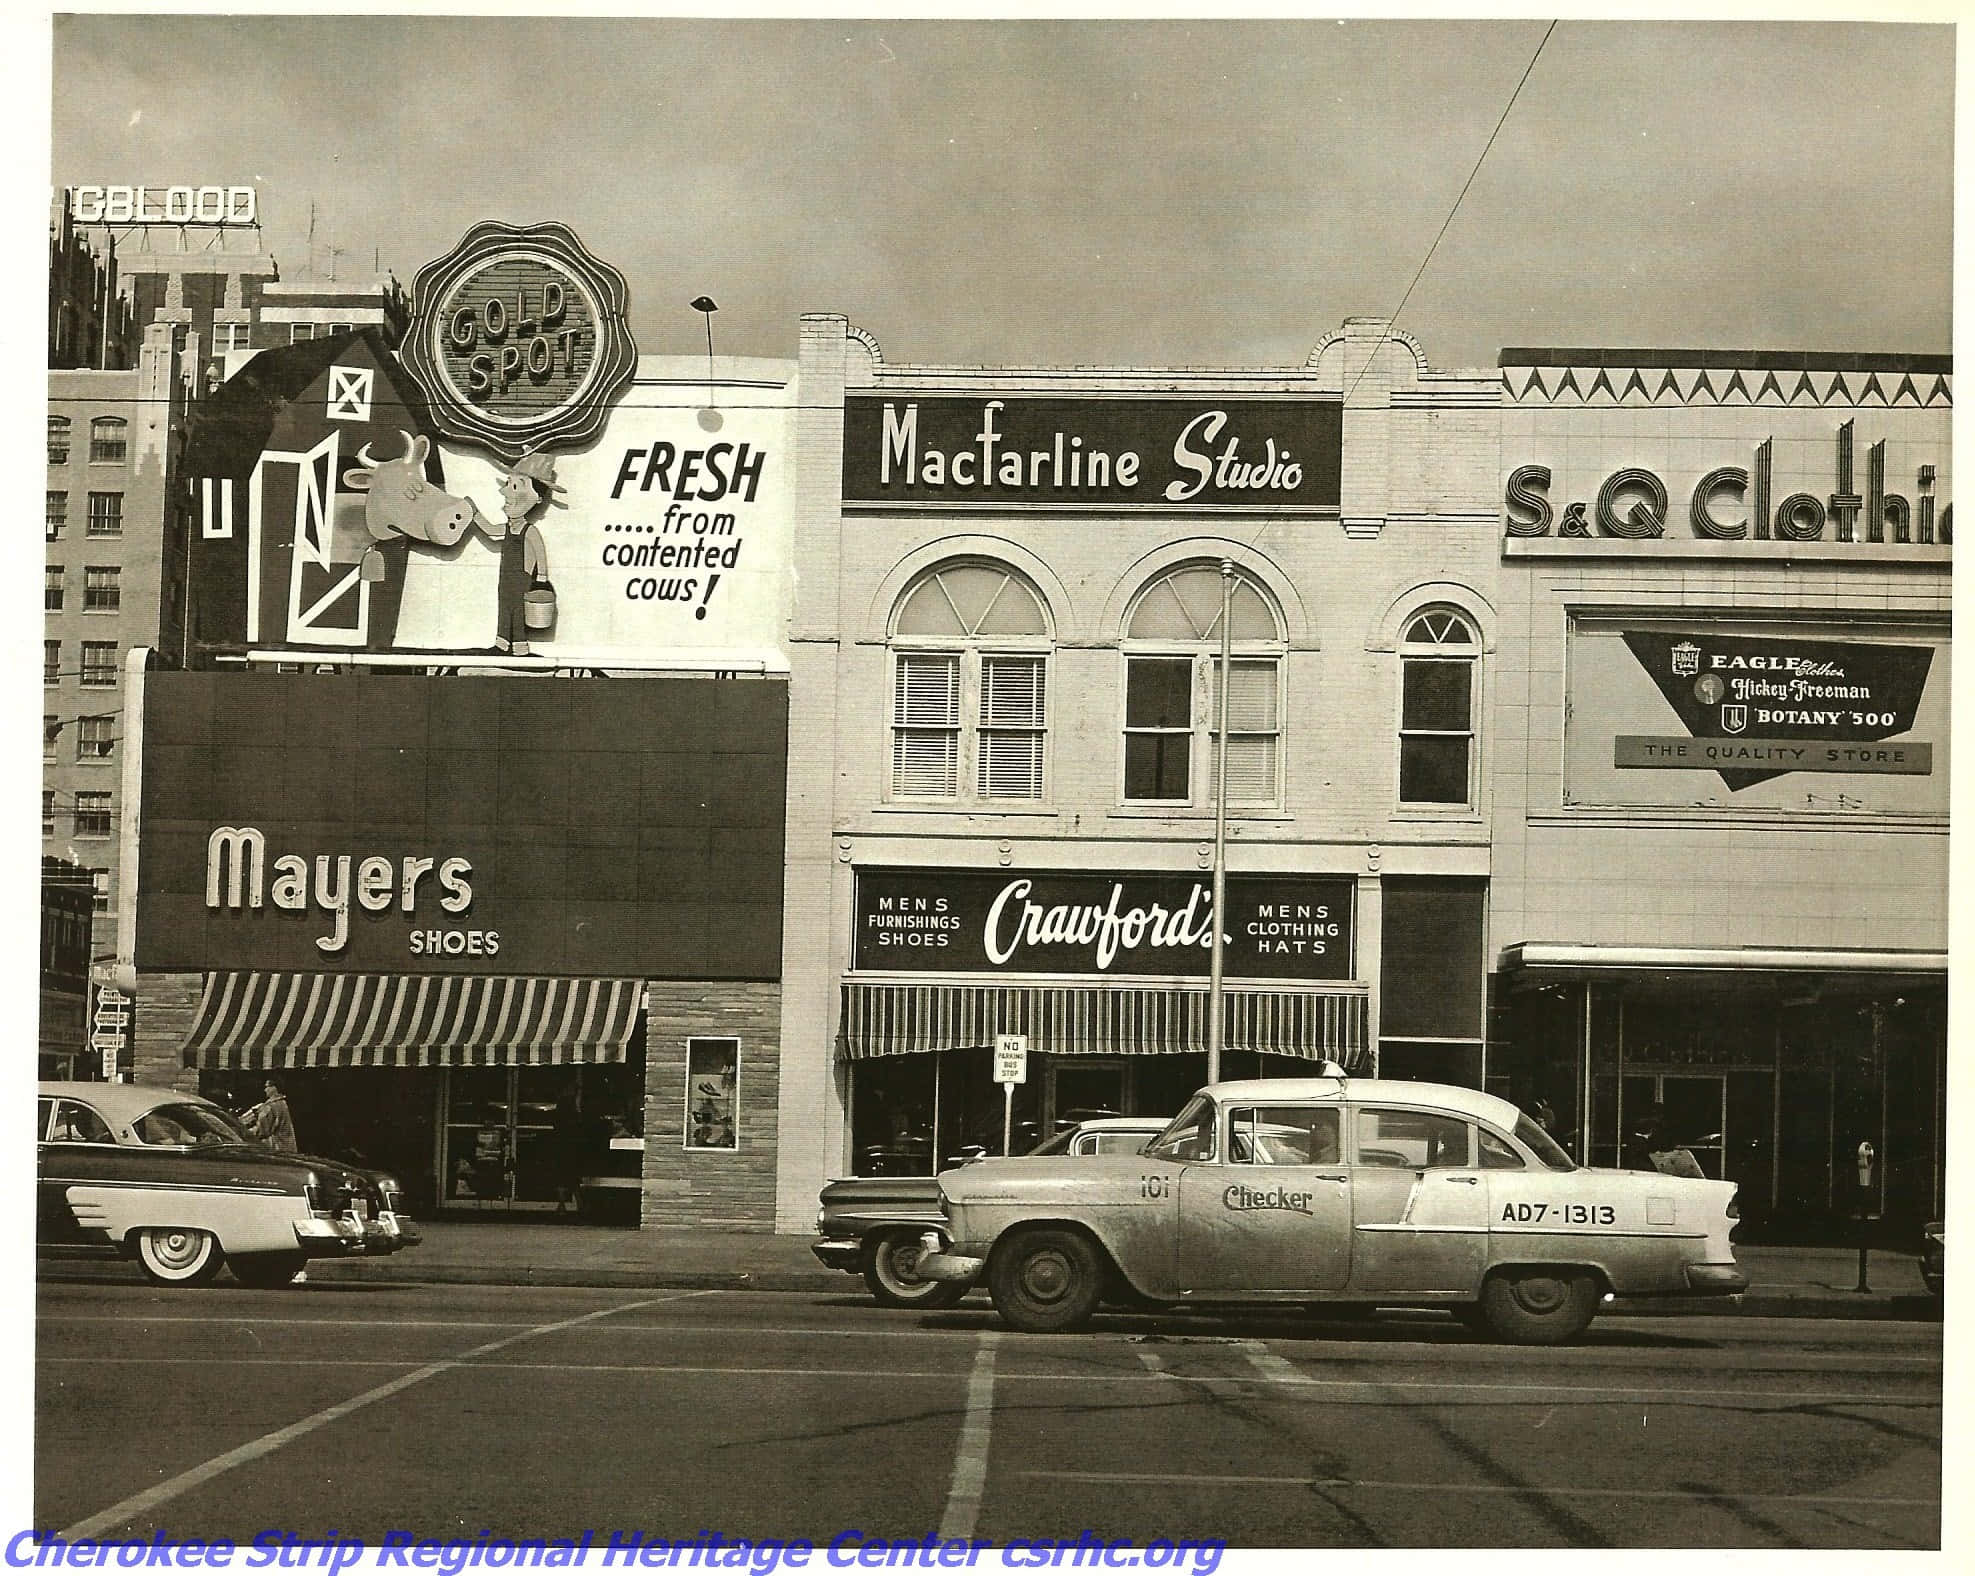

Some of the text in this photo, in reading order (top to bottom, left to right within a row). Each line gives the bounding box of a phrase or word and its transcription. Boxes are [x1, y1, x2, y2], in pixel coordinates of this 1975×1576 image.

[450, 282, 565, 347] GOLD
[469, 328, 578, 391] SPOT
[879, 400, 1303, 502] Macfarline Studio
[610, 441, 767, 502] FRESH
[1690, 416, 1953, 546] Clothi
[602, 536, 743, 569] contented
[626, 574, 721, 621] cows!
[1710, 655, 1801, 670] EAGLE
[1645, 744, 1905, 763] THE QUALITY STORE
[205, 825, 473, 952] Mayers
[879, 897, 949, 912] MENS
[1258, 904, 1329, 919] MENS
[868, 914, 961, 930] FURNISHINGS
[983, 879, 1233, 970] Crawford's
[1247, 922, 1339, 937] CLOTHING
[409, 930, 501, 955] SHOES
[878, 932, 949, 946] SHOES
[1258, 940, 1326, 955] HATS
[998, 1052, 1024, 1060] PARKING
[1003, 1042, 1019, 1051] NO
[1003, 1061, 1018, 1069] BUS
[1141, 1175, 1169, 1198] 101
[1222, 1185, 1314, 1216] Checker
[1501, 1203, 1615, 1225] AD7-1313
